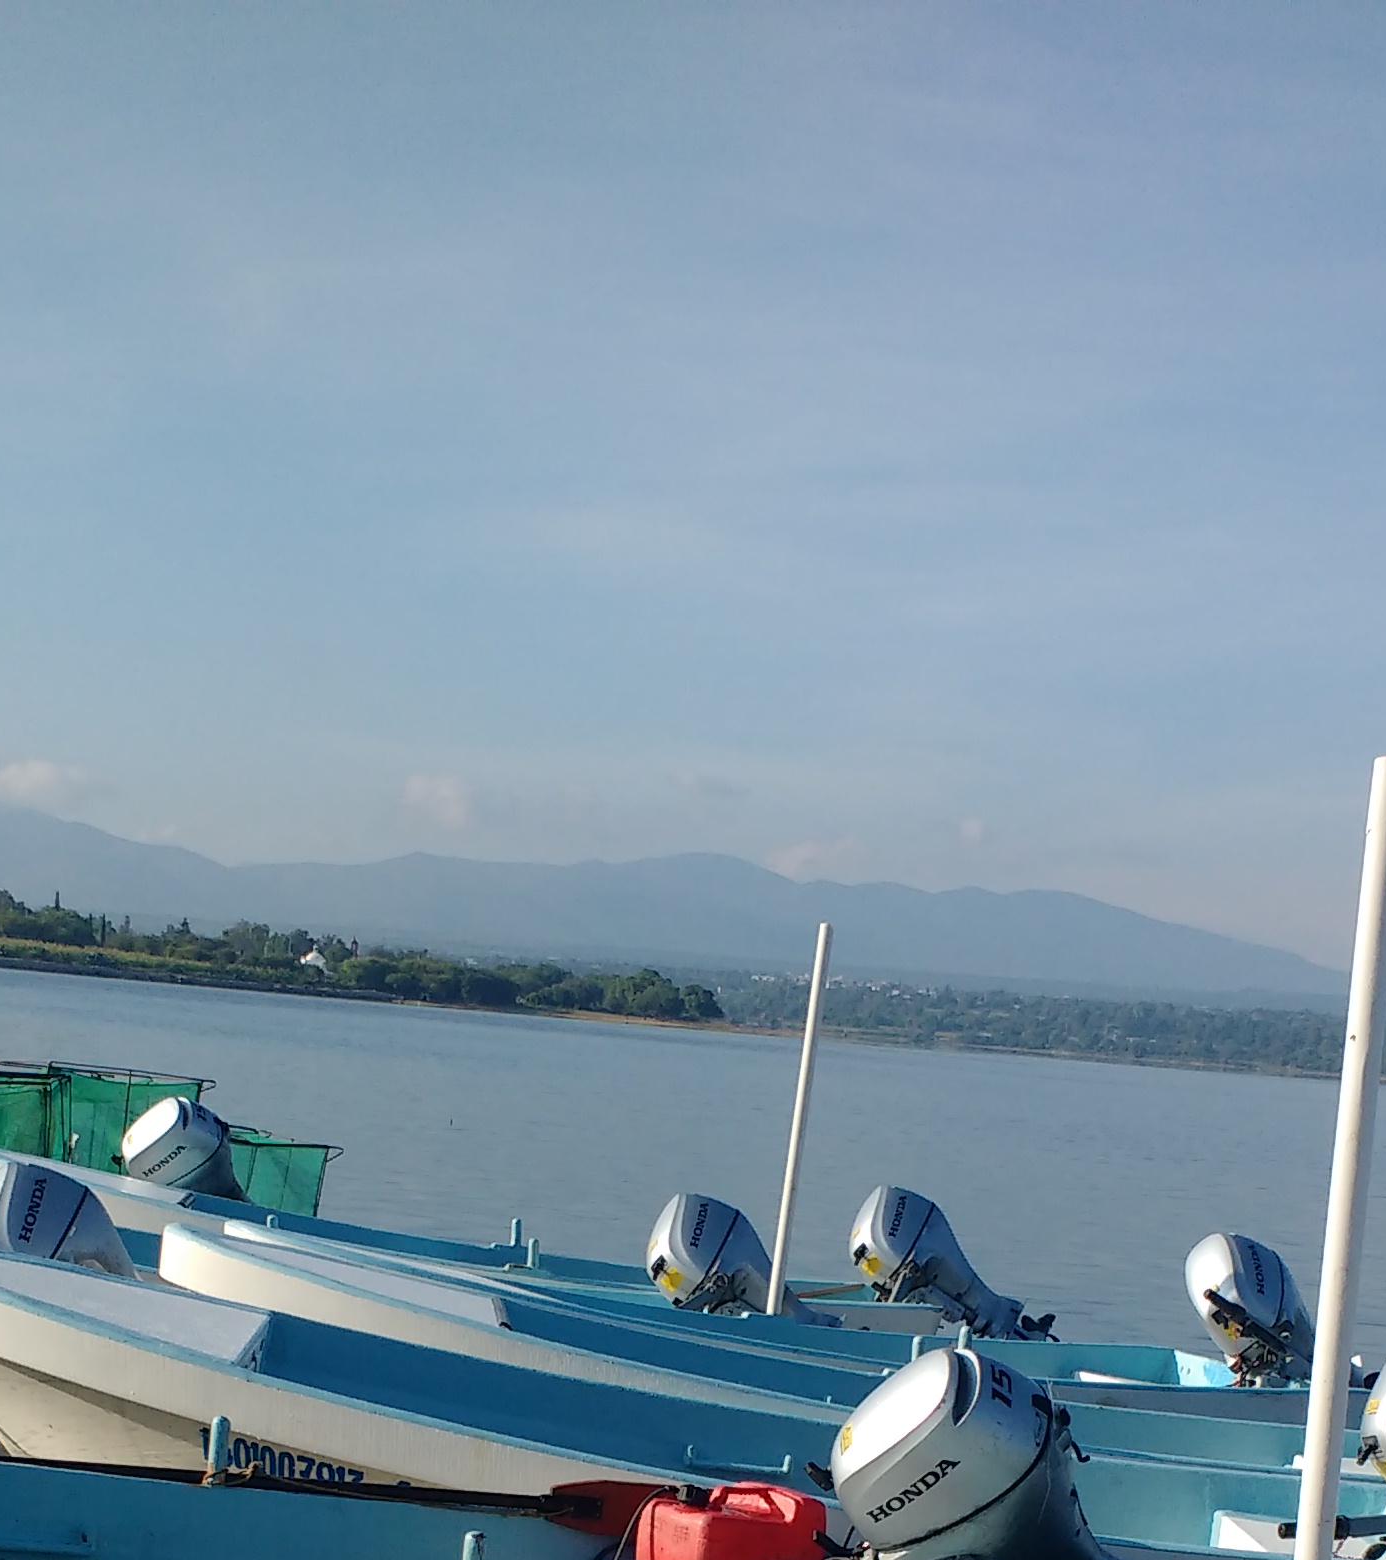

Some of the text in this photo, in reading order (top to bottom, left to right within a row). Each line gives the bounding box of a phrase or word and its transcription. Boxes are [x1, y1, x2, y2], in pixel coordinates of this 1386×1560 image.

[142, 1144, 188, 1178] HONDA
[18, 1177, 48, 1244] HONDA
[689, 1202, 710, 1250] HONDA
[888, 1195, 908, 1239] HONDA
[1246, 1244, 1266, 1297] HONDA
[990, 1363, 1013, 1409] 15
[865, 1456, 962, 1524] HONDA
